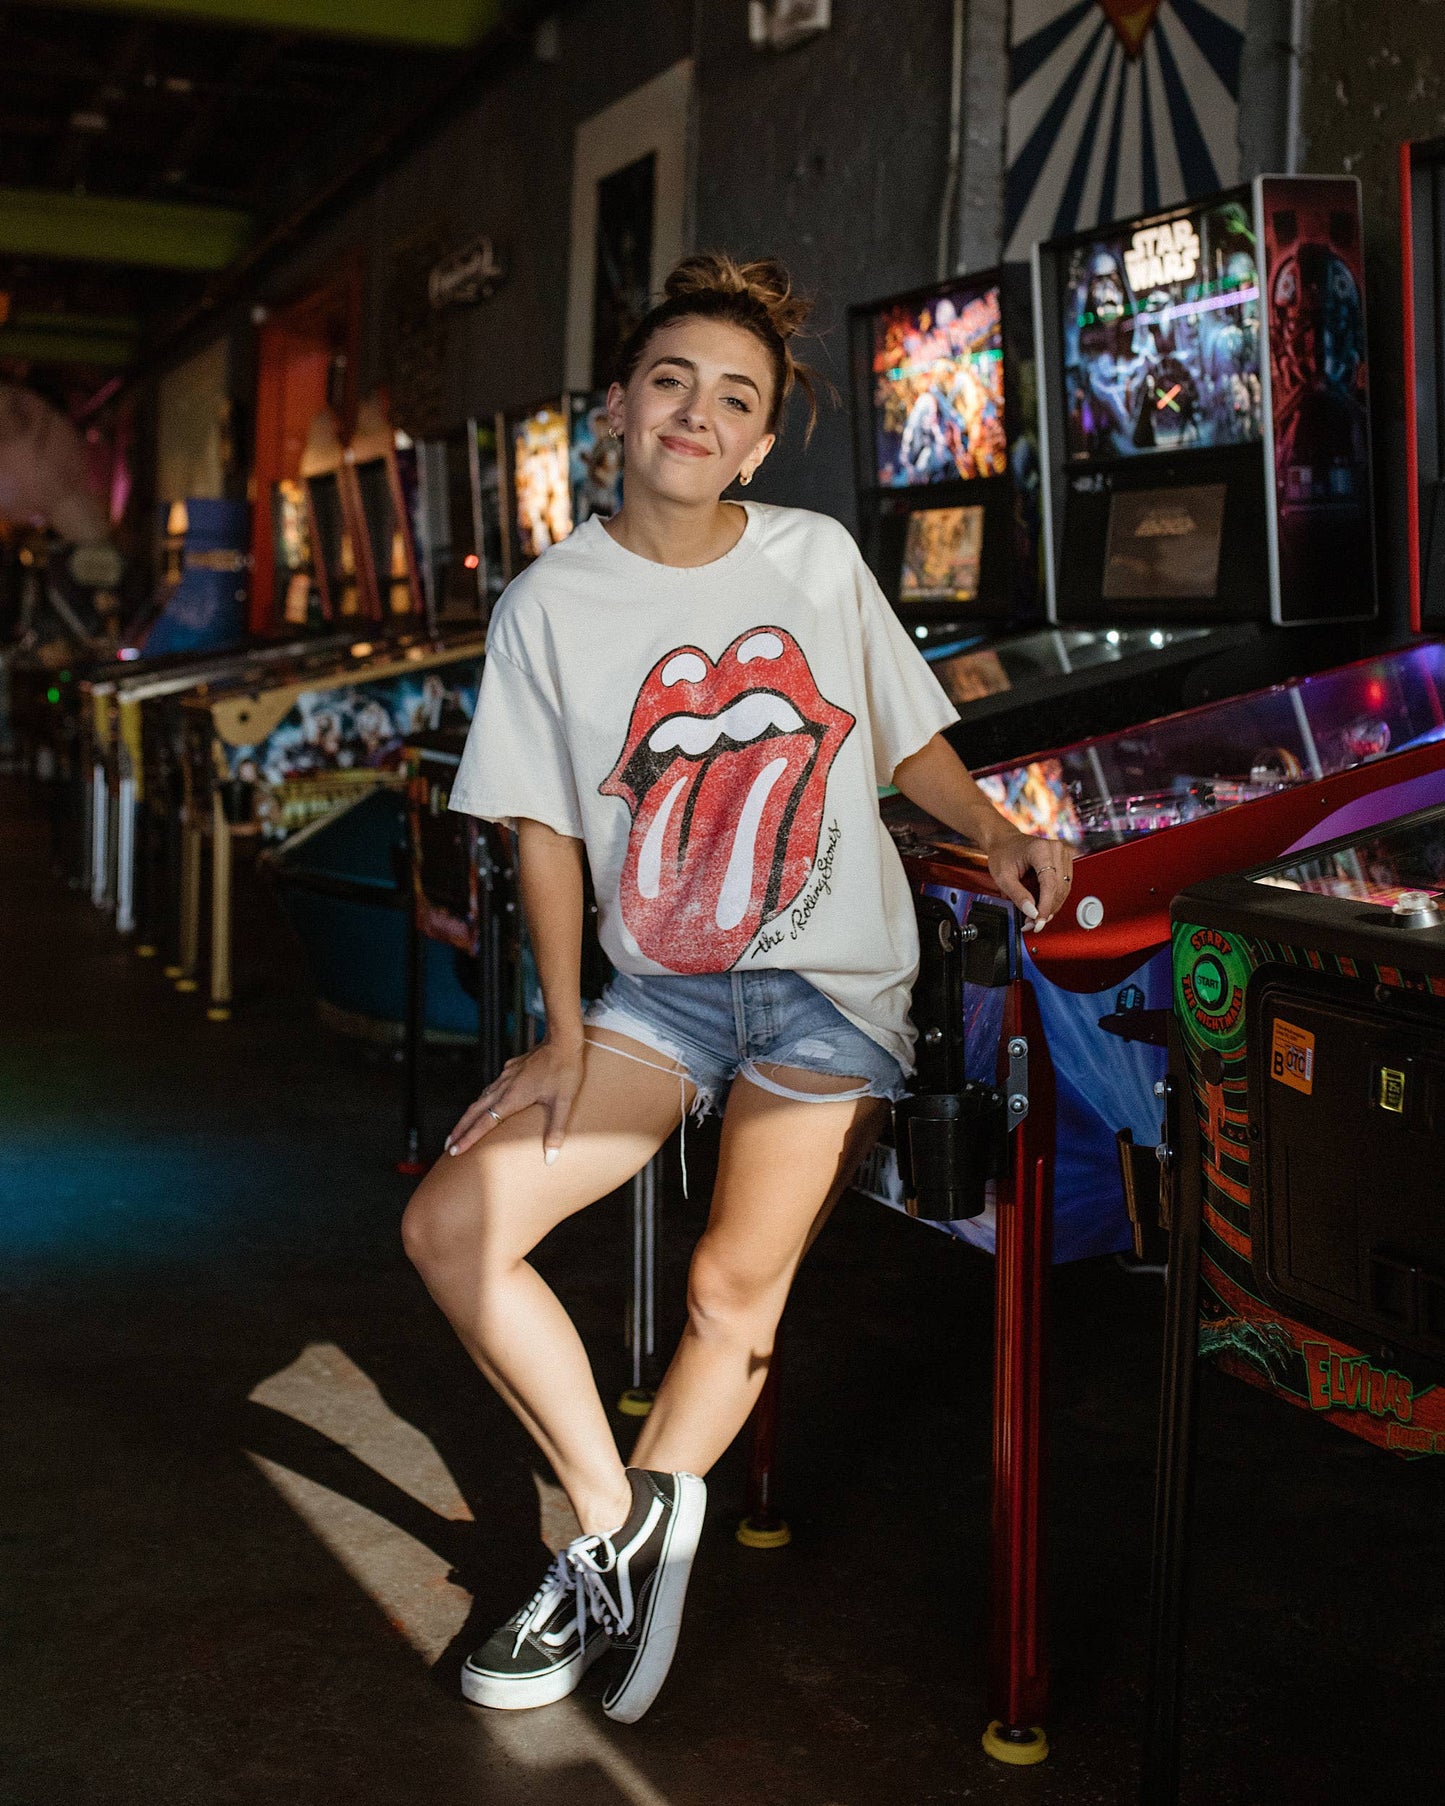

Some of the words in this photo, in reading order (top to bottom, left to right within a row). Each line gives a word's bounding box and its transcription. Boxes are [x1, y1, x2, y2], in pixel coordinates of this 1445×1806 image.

[1124, 219, 1200, 260] STAR
[1124, 248, 1198, 292] WARS
[790, 879, 832, 940] Rolling
[817, 818, 841, 880] Stones
[1191, 929, 1232, 955] START
[1182, 974, 1197, 1010] THE
[1195, 985, 1243, 1031] NIGHTMARE
[1197, 976, 1219, 990] START
[1274, 1050, 1284, 1076] B
